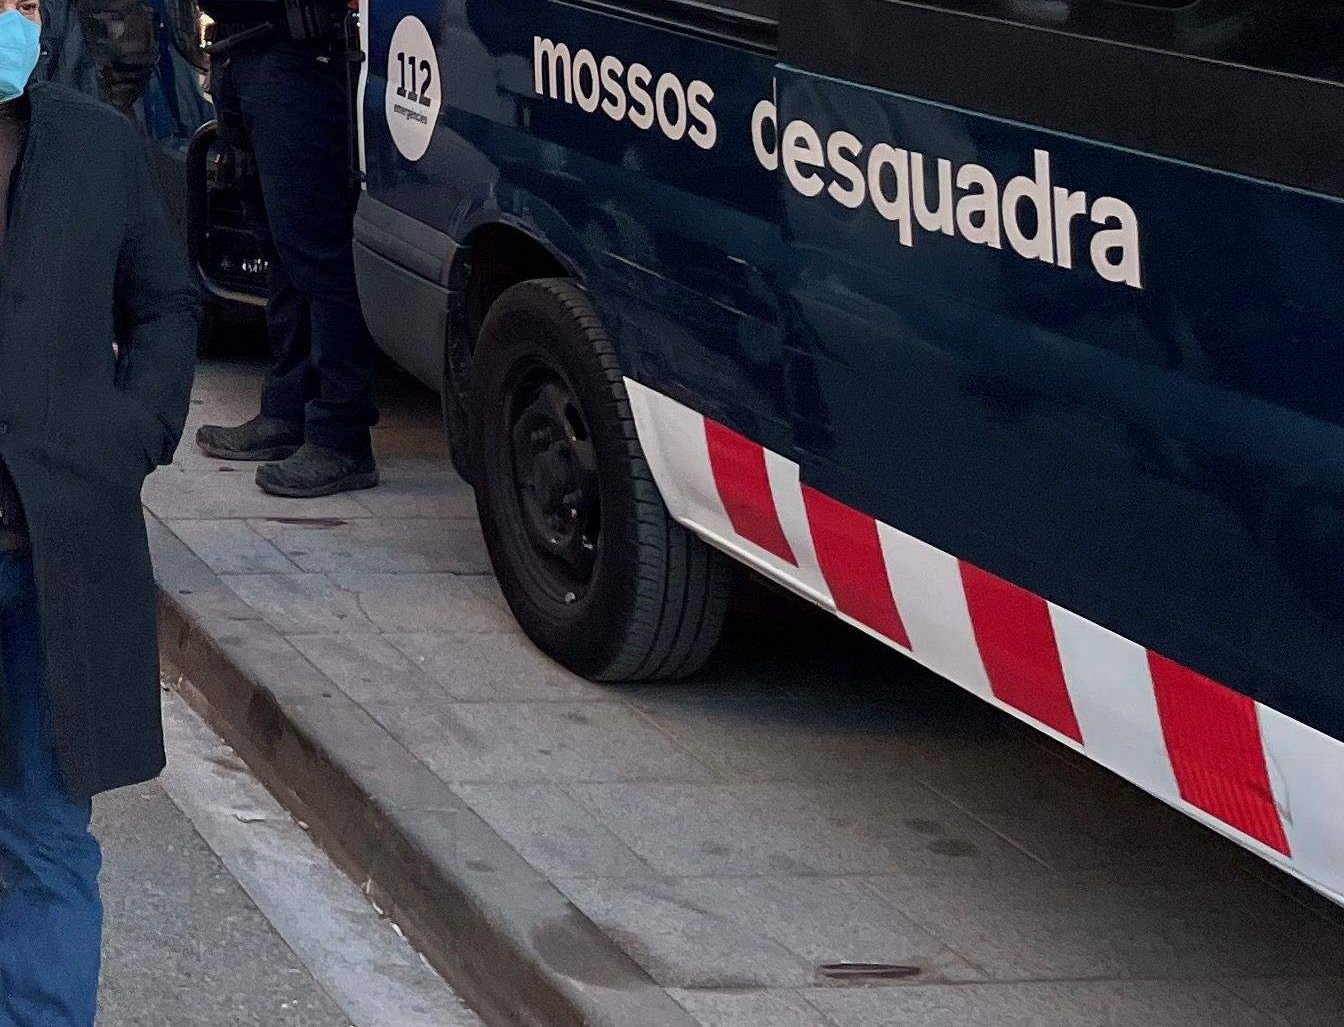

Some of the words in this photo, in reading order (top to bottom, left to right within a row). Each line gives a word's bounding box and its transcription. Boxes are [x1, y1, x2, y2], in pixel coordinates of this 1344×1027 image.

[397, 52, 431, 107] 112
[533, 35, 717, 150] mossos
[750, 76, 1144, 289] desquadra
